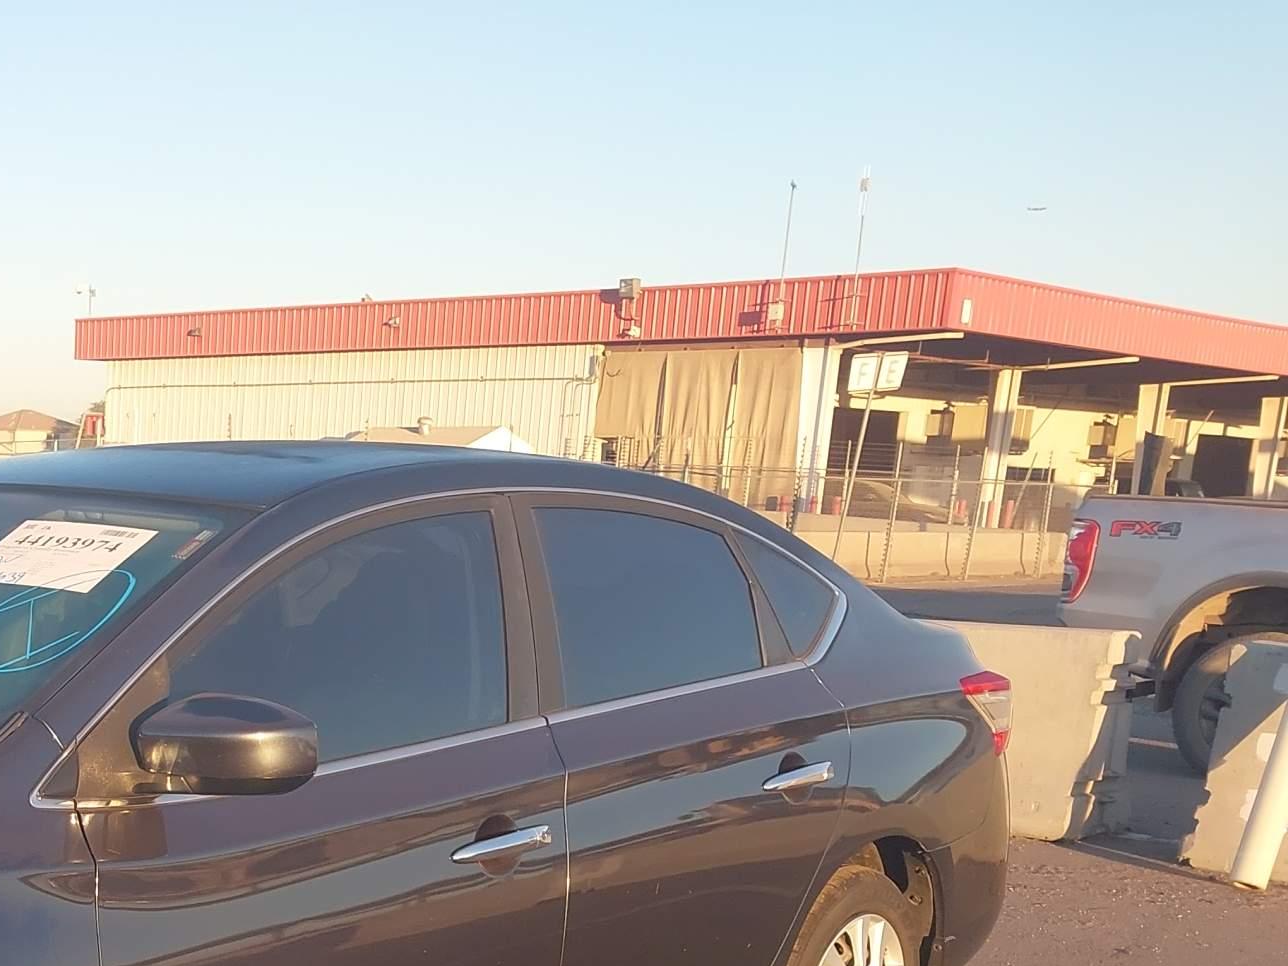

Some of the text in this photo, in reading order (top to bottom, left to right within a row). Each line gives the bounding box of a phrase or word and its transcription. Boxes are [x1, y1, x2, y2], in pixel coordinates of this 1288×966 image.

[856, 359, 899, 386] F E
[1109, 520, 1182, 537] FX4
[14, 534, 123, 553] 44193974
